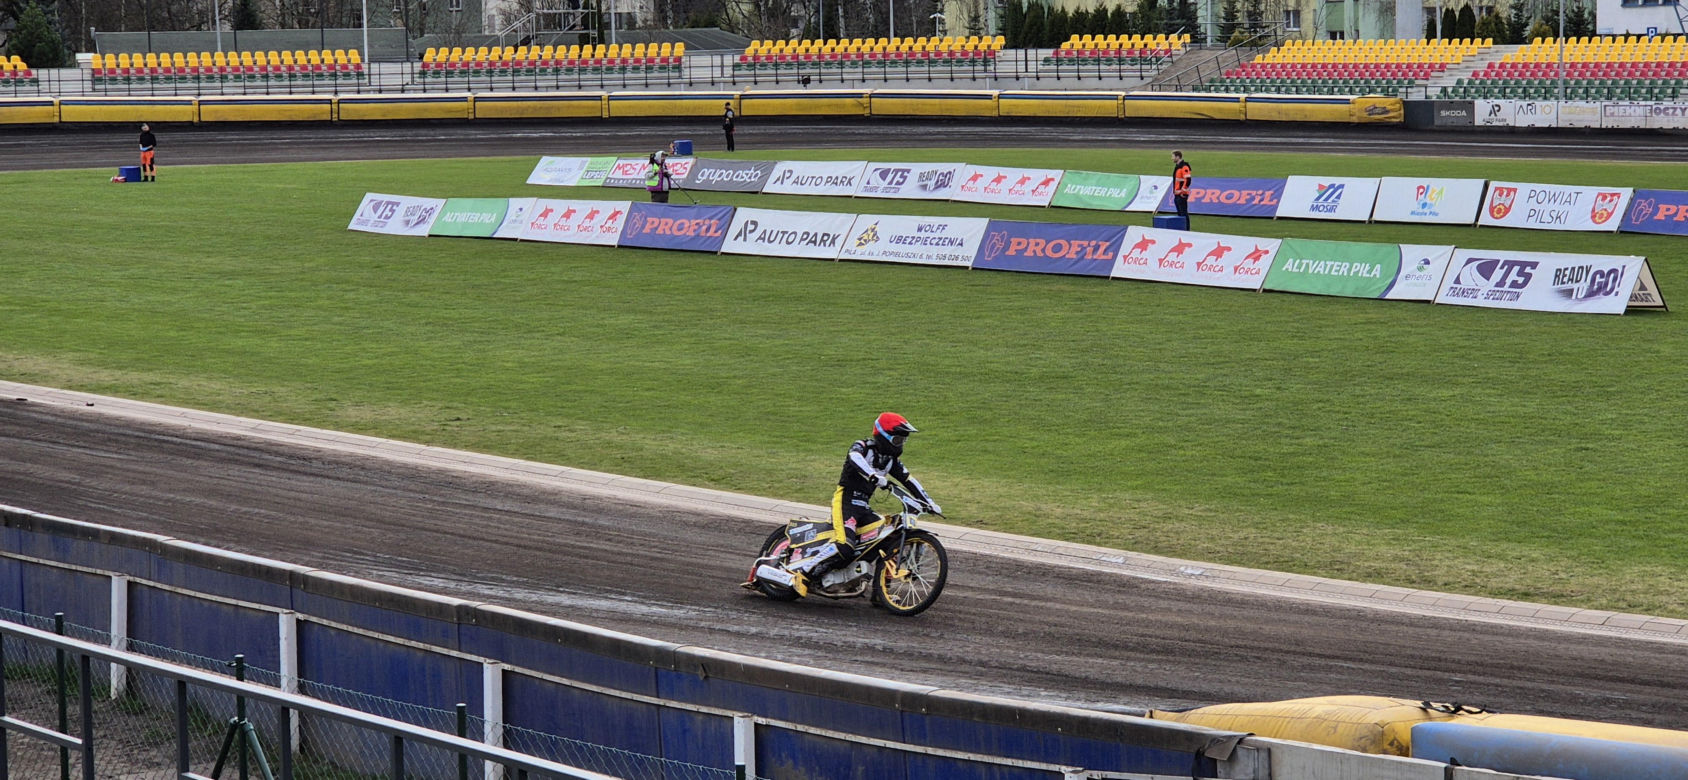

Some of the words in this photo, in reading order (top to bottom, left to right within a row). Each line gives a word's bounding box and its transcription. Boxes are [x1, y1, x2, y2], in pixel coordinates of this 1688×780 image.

[1654, 106, 1688, 117] OCZY
[791, 175, 824, 187] AUTO
[824, 177, 855, 187] PARK
[887, 168, 912, 186] TS
[1526, 190, 1583, 206] POWIAT
[377, 201, 401, 220] TS
[1526, 208, 1569, 224] PILSKI
[916, 223, 948, 233] WOLFF
[755, 229, 798, 245] AUTO
[798, 232, 841, 247] PARK
[888, 235, 964, 247] UBEZPIECZENIA
[1282, 258, 1349, 276] ALTVATER
[1350, 262, 1381, 278] PIŁA
[1494, 260, 1540, 289] TS
[1552, 265, 1592, 286] READY
[1405, 273, 1432, 281] eneris
[1588, 265, 1626, 297] GO!
